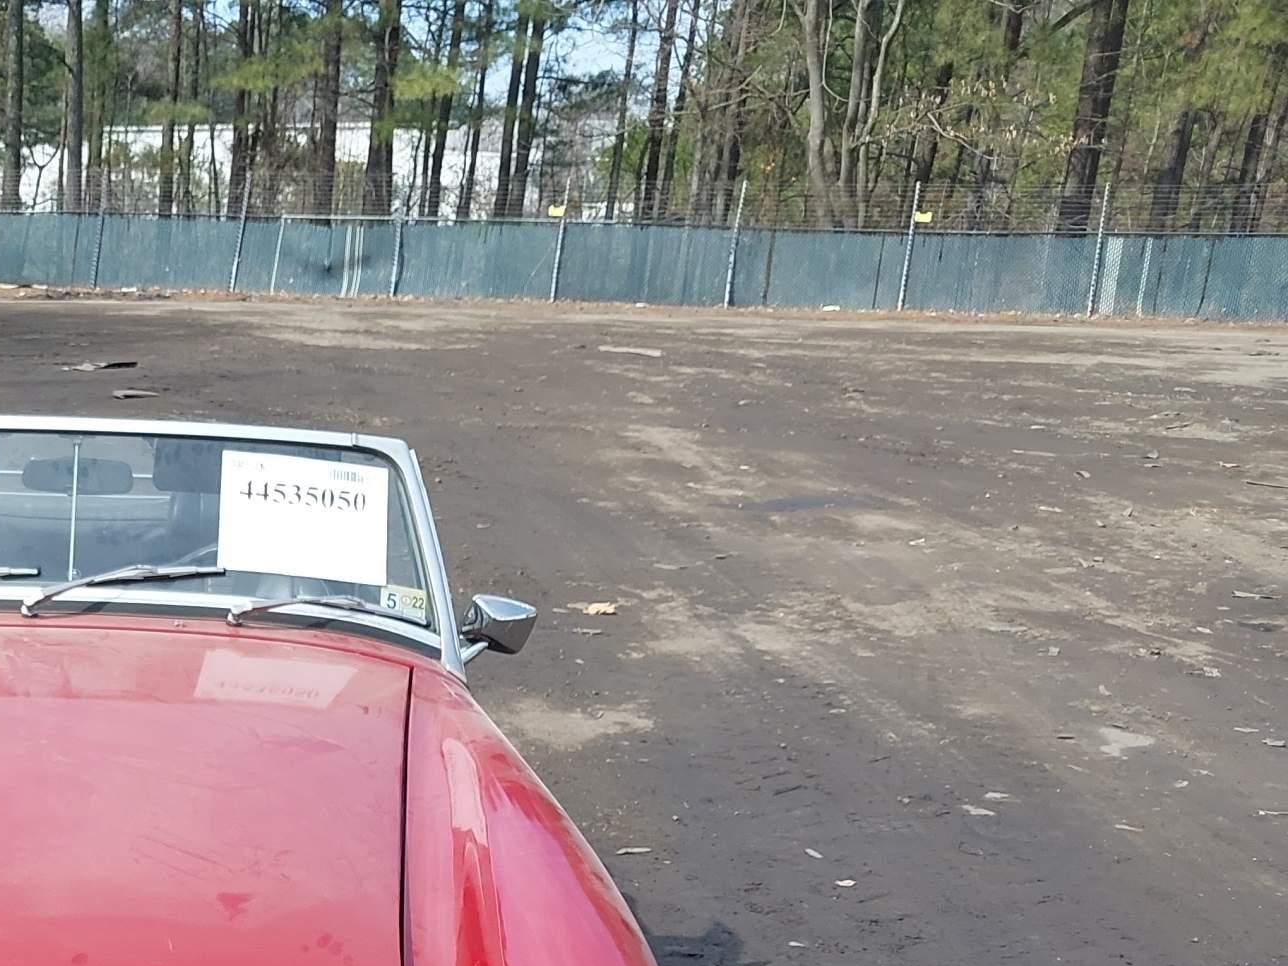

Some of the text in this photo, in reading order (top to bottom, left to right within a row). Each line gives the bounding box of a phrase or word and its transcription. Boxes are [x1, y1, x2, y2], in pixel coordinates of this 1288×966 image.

[239, 479, 367, 512] 44535050
[386, 592, 425, 611] 5 22
